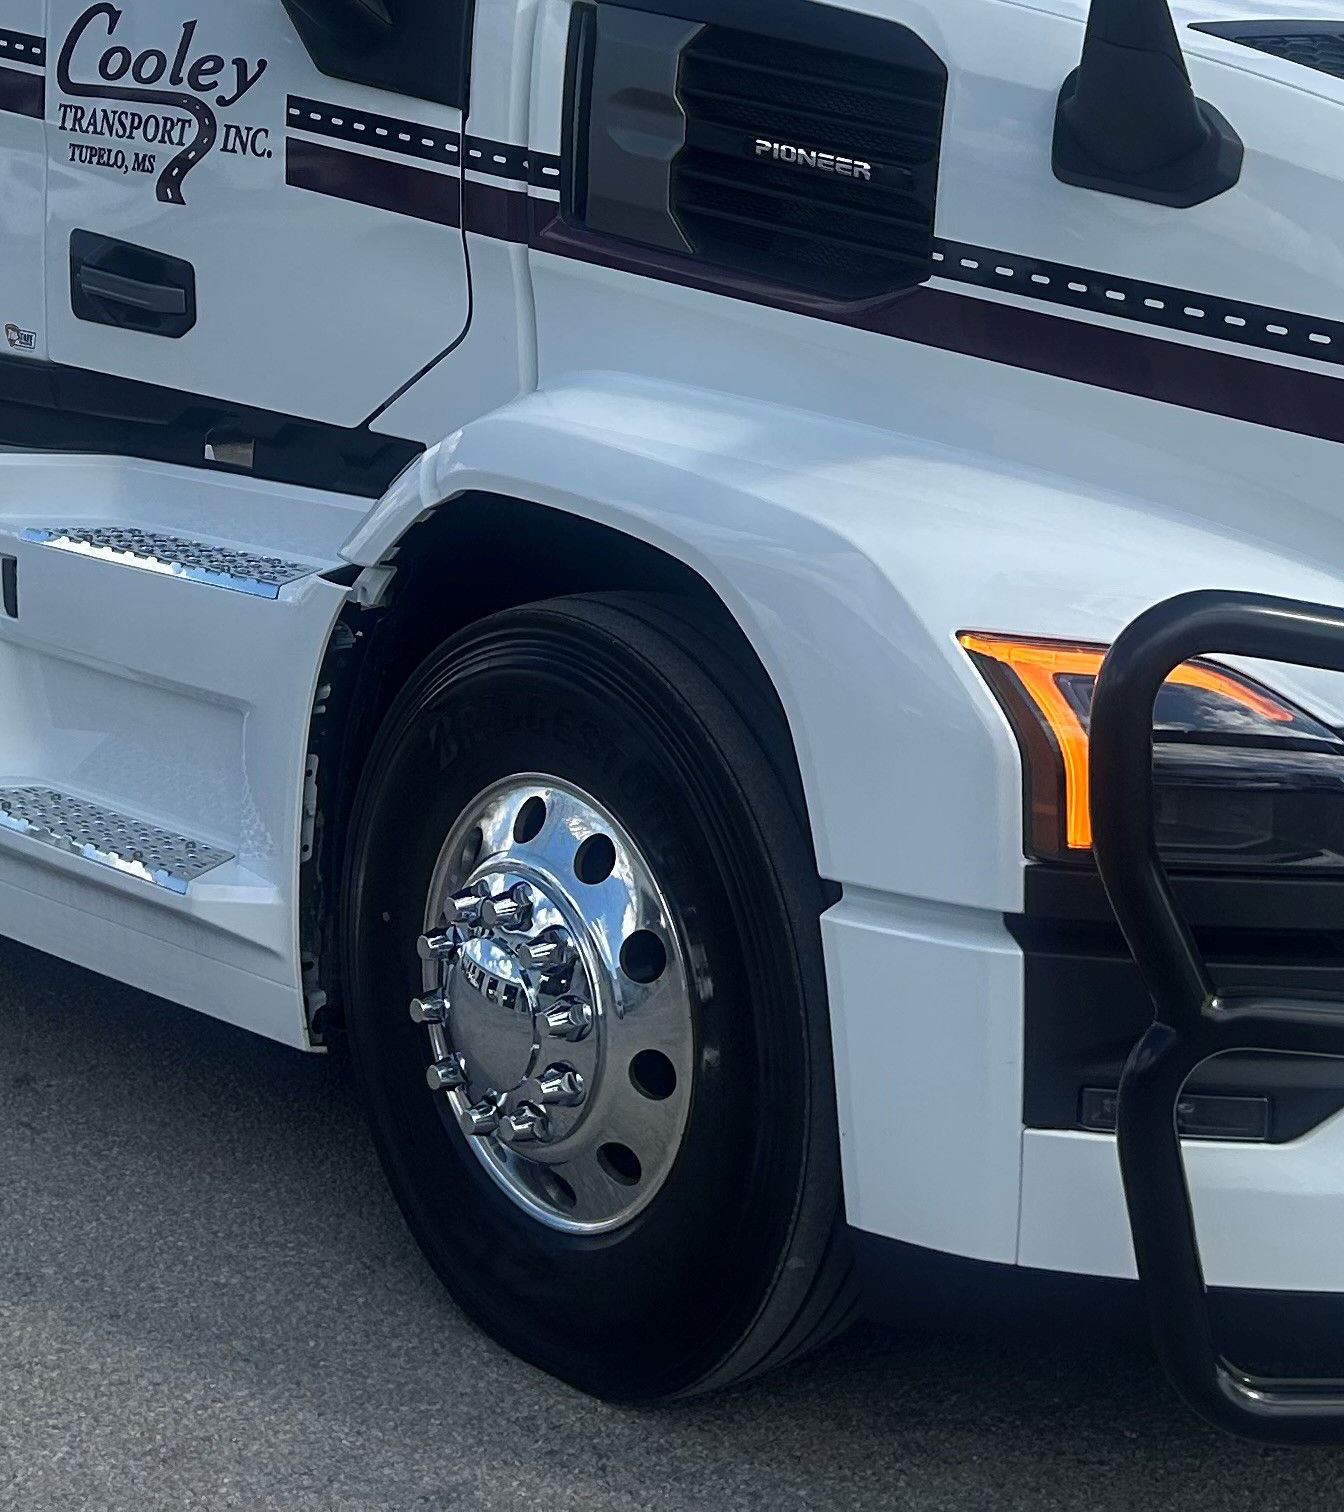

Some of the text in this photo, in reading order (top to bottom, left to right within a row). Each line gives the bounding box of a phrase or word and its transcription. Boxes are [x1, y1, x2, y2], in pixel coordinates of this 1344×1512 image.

[56, 1, 269, 108] Cooley
[57, 102, 273, 159] TRANSPORT INC.
[68, 142, 156, 175] TUPELO, MS
[755, 138, 872, 181] PIONEER
